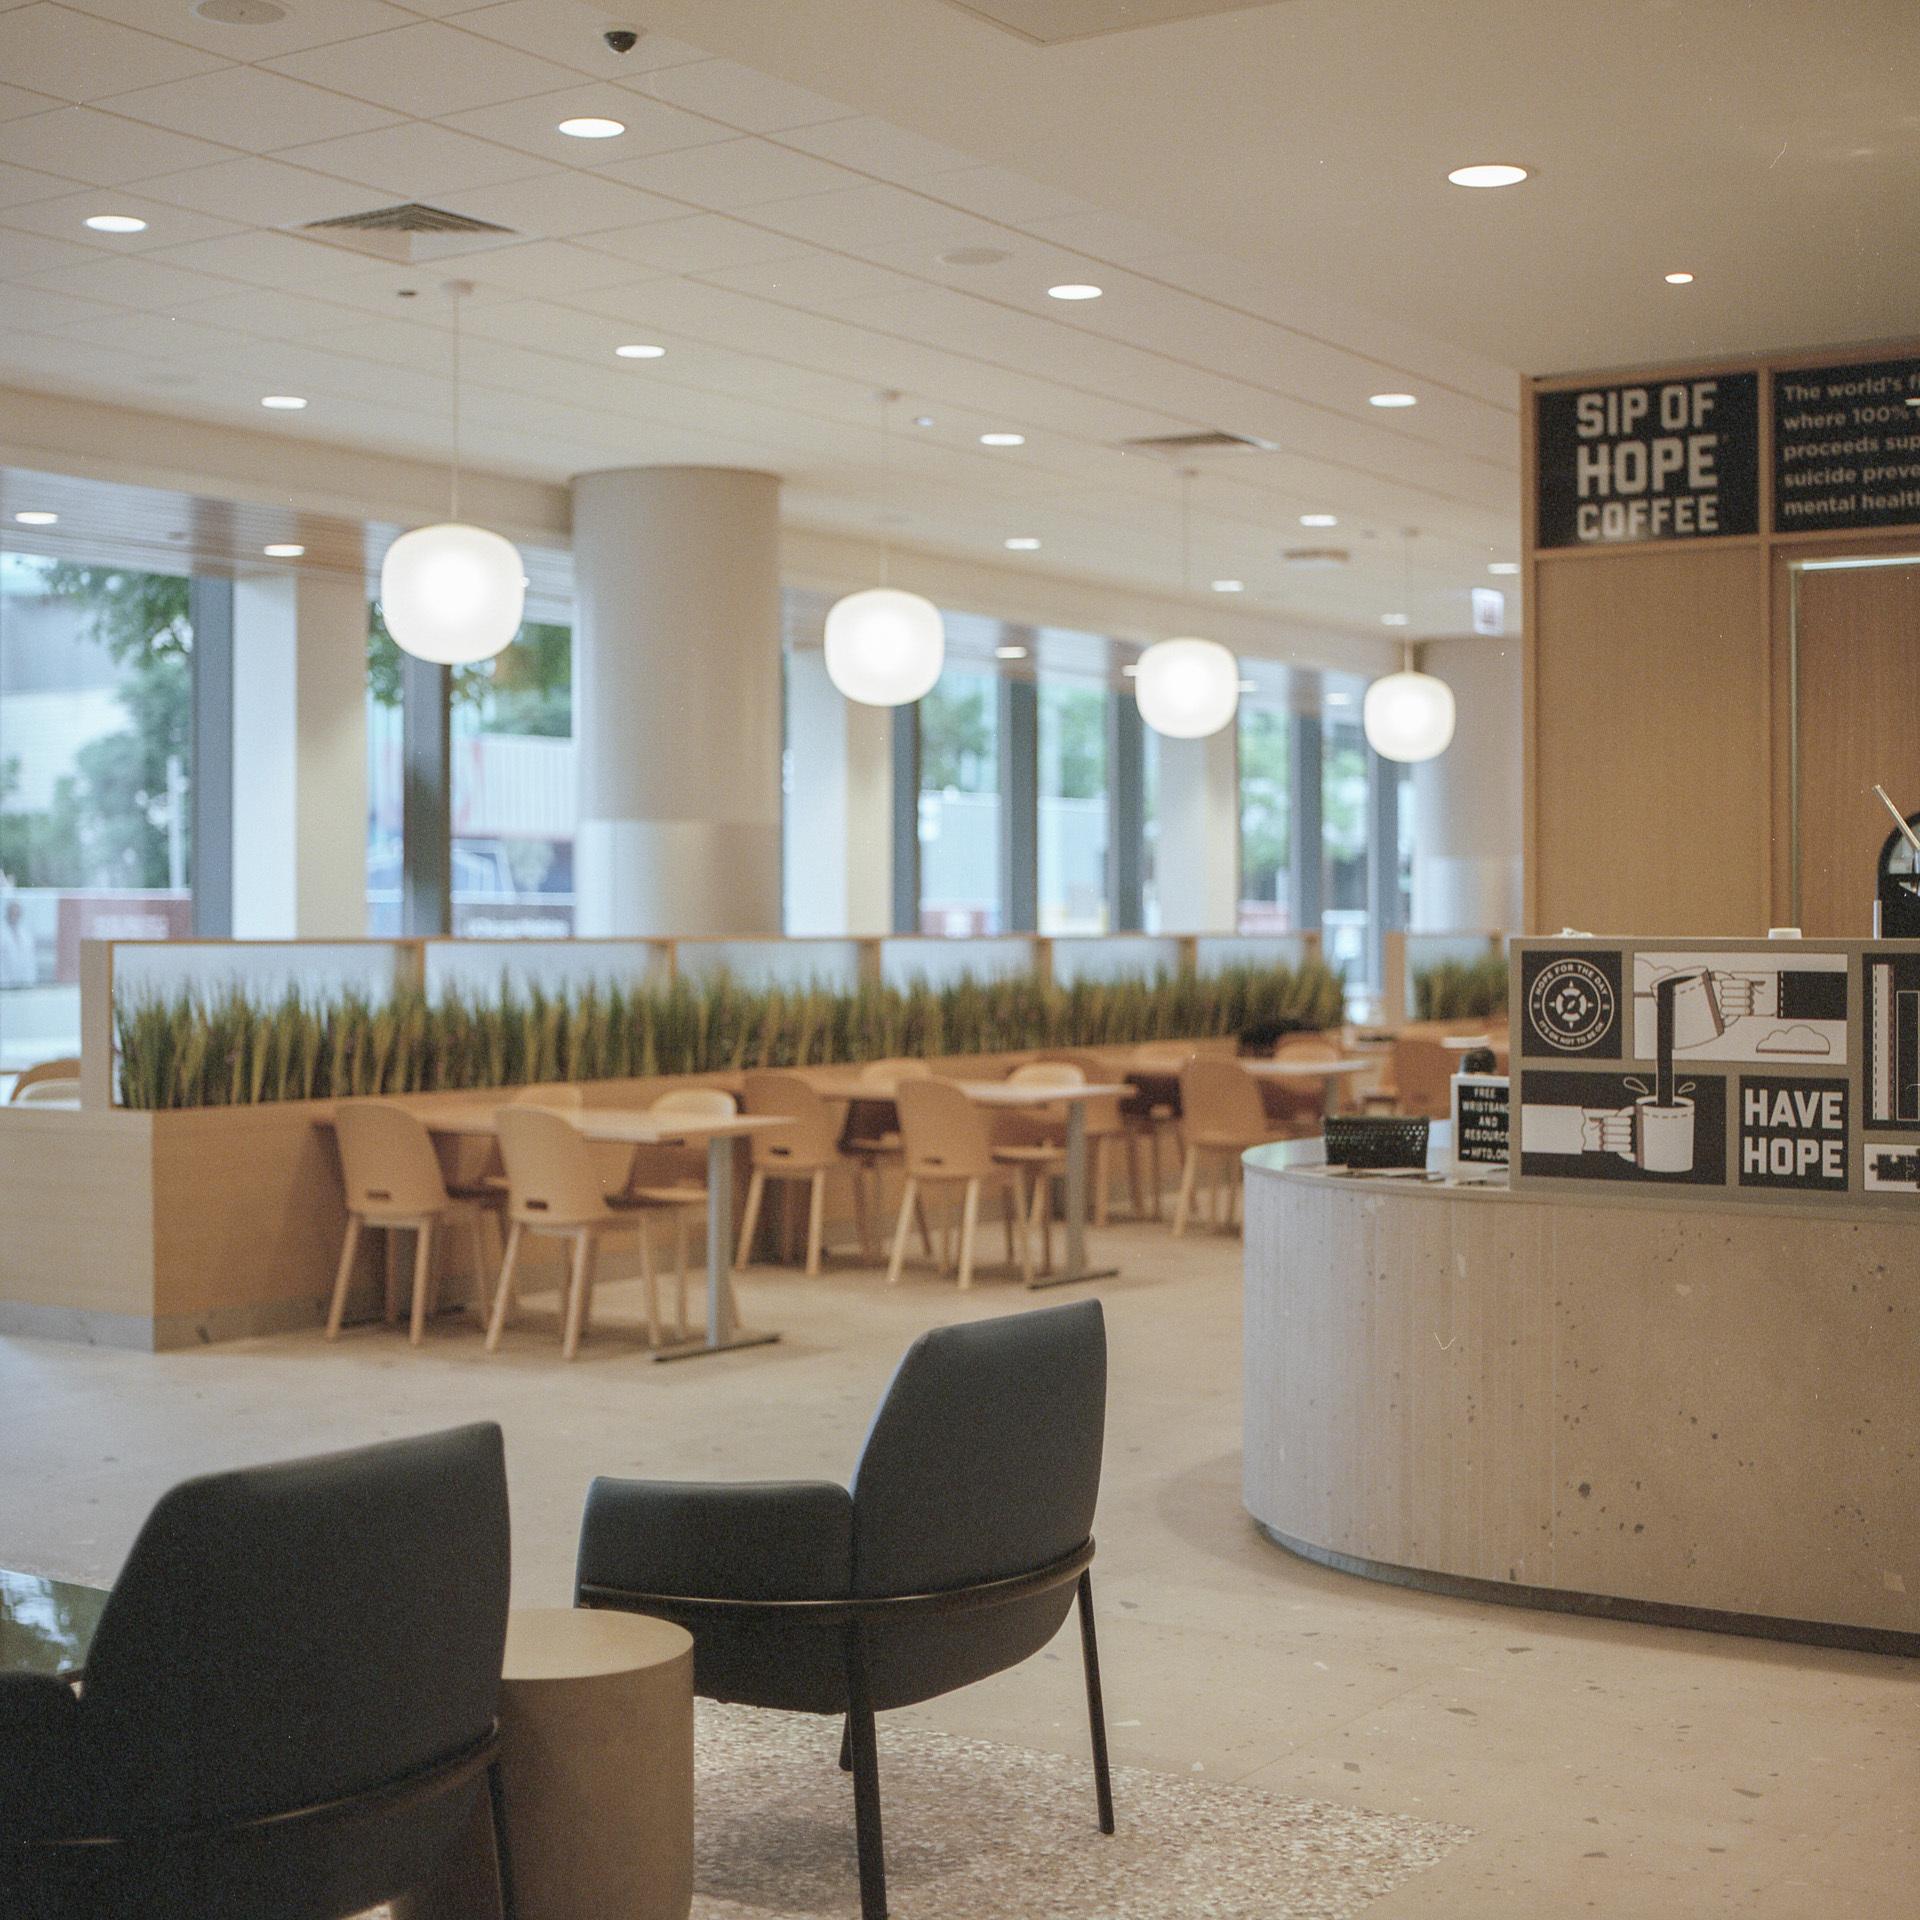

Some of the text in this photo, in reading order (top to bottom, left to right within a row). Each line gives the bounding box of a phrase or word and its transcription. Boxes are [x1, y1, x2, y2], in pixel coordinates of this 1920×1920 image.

[1784, 384, 1820, 400] The
[1827, 376, 1903, 397] world's
[1577, 381, 1717, 438] SIP OF
[1783, 412, 1847, 430] where
[1853, 406, 1910, 424] 100%
[1783, 436, 1880, 463] proceeds
[1576, 434, 1718, 498] HOPE
[1784, 465, 1857, 488] suicide
[1577, 494, 1719, 541] COFFEE
[1783, 494, 1856, 516] mental
[1535, 964, 1608, 995] HOPE FOR THE DAY
[1474, 1088, 1495, 1099] FREE
[1479, 1115, 1498, 1128] AND
[1744, 1088, 1843, 1129] HAVE
[1743, 1136, 1843, 1178] HOPE
